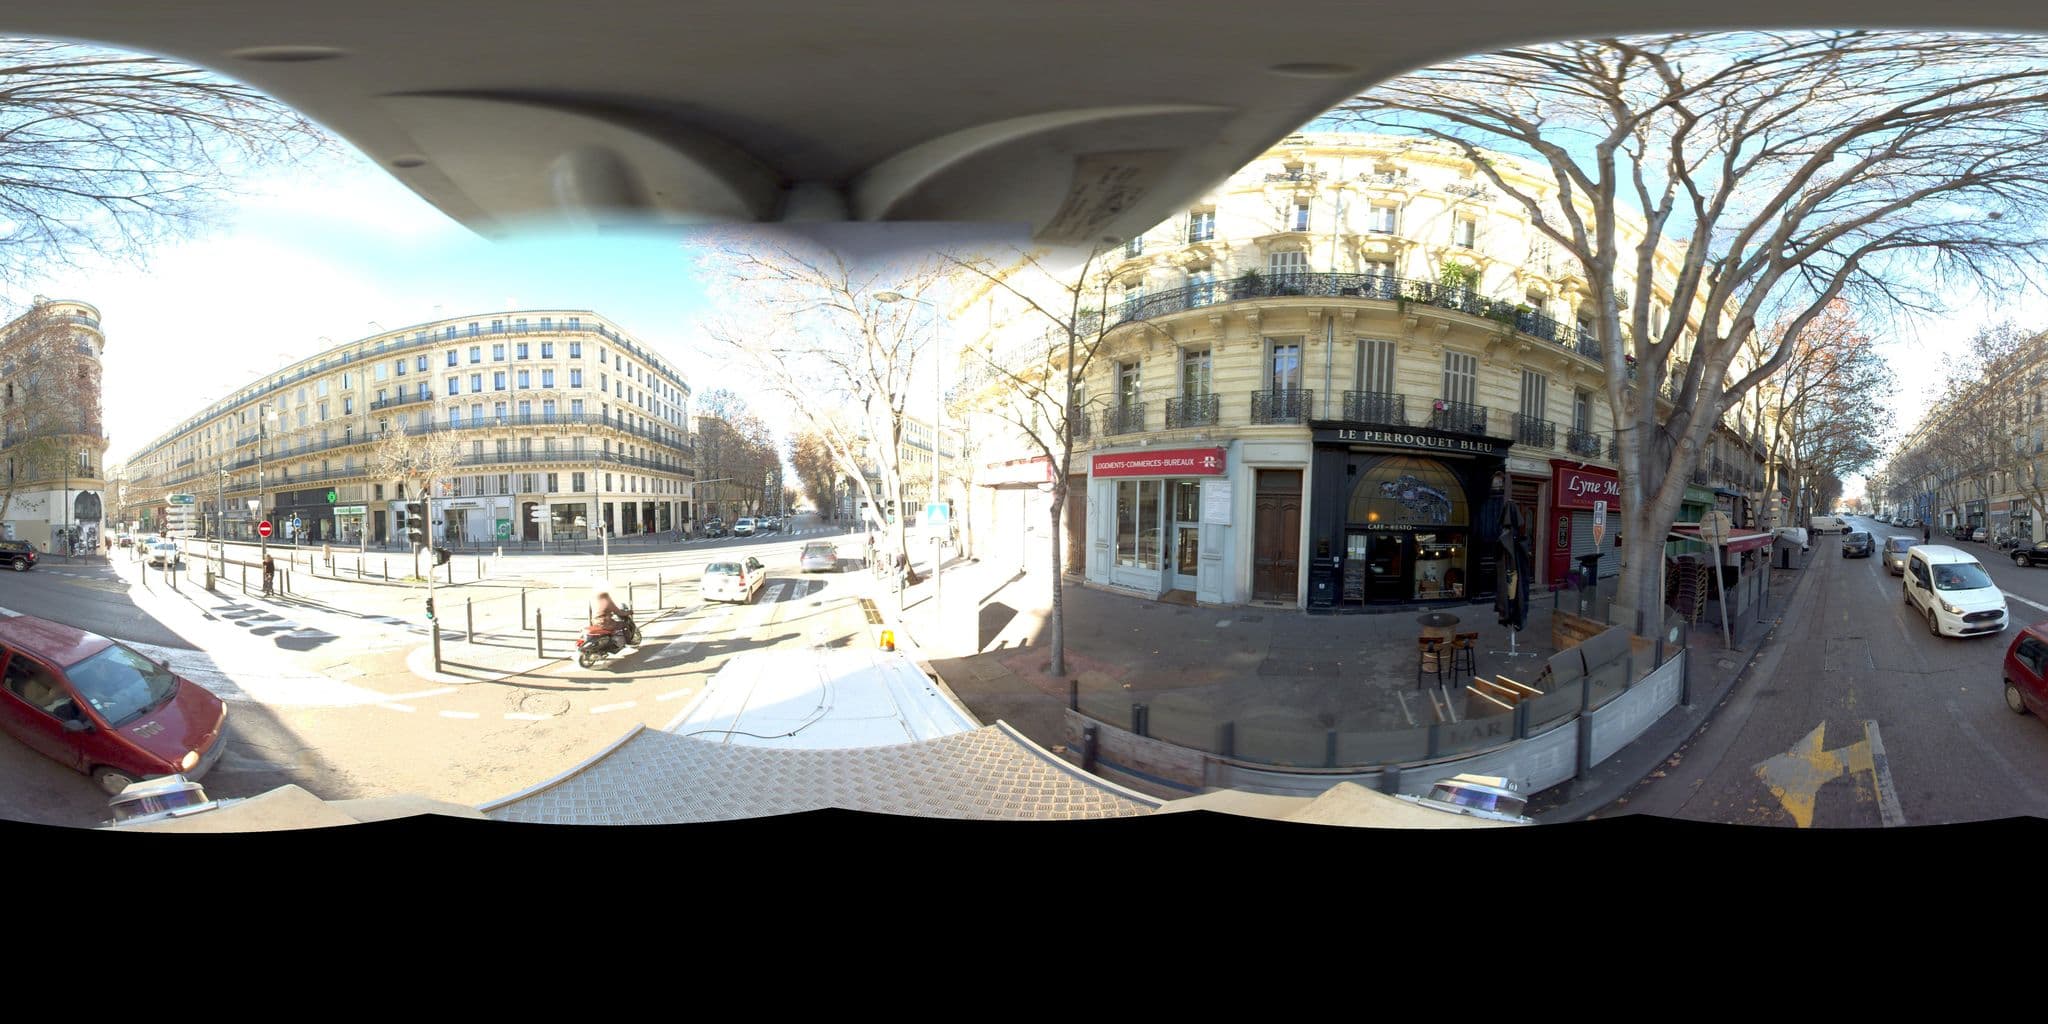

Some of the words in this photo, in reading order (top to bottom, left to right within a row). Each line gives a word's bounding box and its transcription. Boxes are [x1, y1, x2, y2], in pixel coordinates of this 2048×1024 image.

[1338, 429, 1357, 439] LE
[1364, 431, 1454, 447] PERROQUET
[1460, 440, 1493, 453] BLEU
[1568, 475, 1600, 496] Lyne
